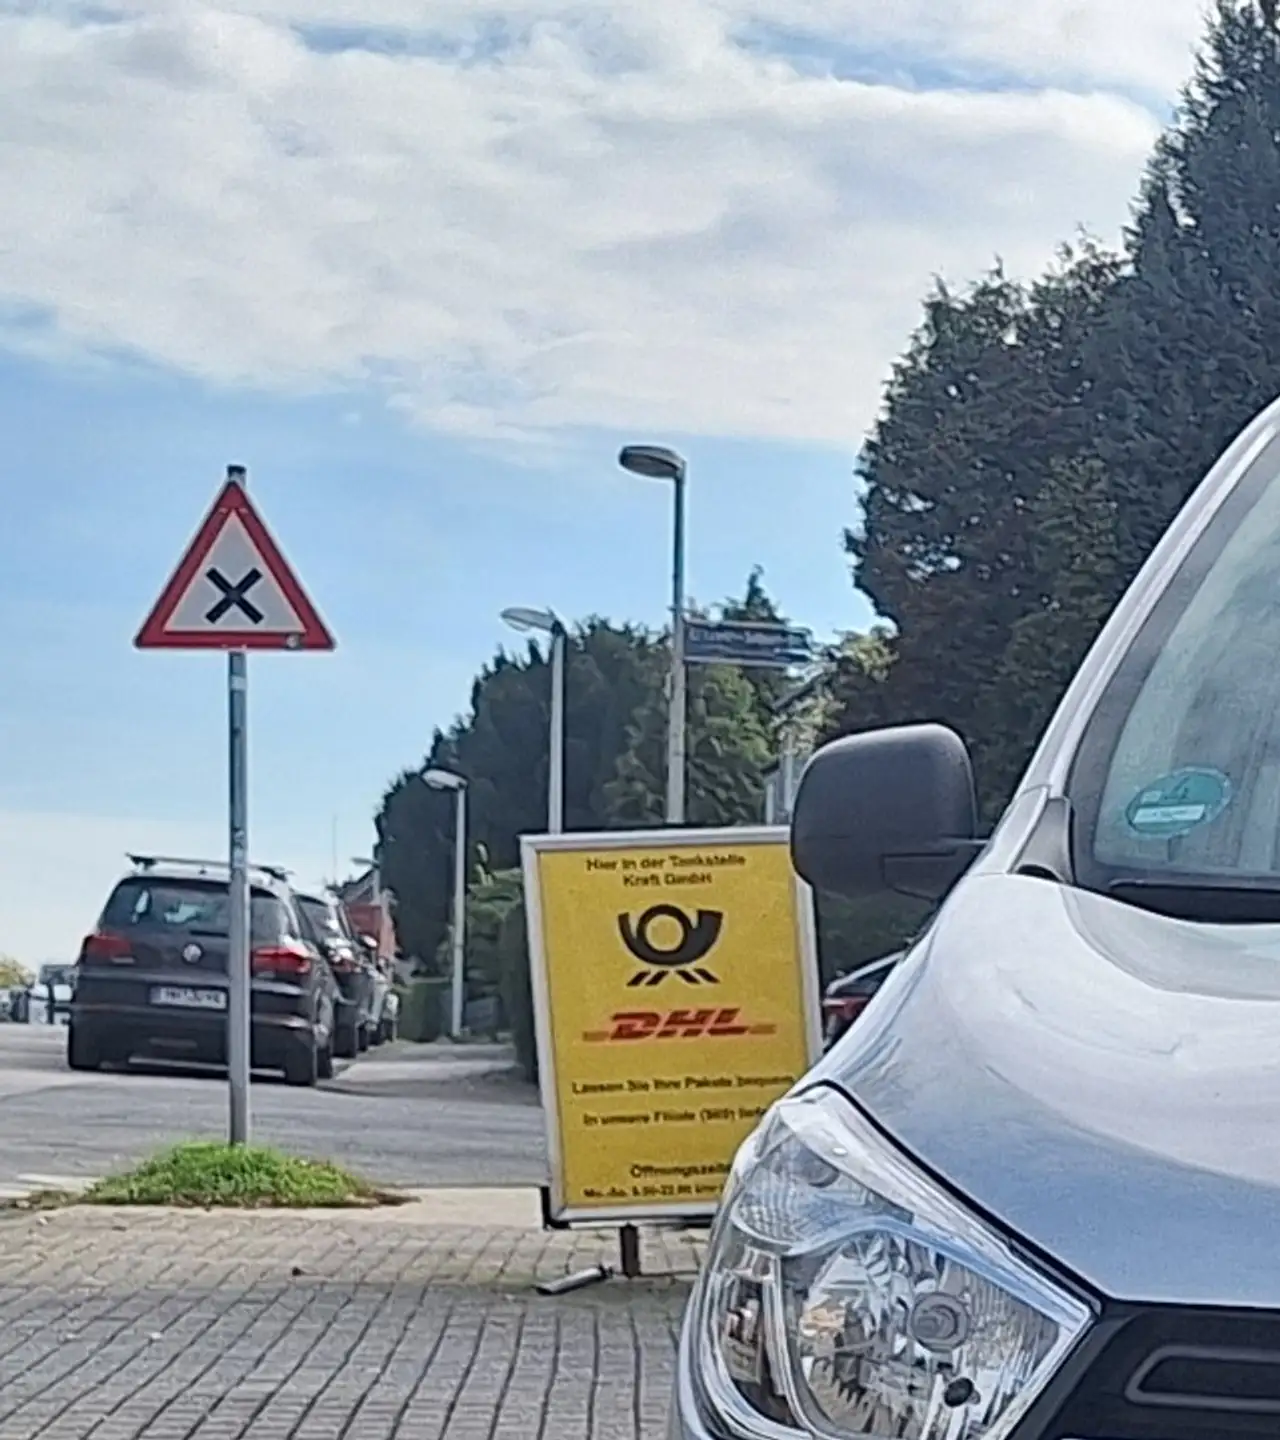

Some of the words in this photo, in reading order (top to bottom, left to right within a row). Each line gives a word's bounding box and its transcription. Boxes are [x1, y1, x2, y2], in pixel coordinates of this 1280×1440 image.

[640, 857, 665, 869] der
[670, 854, 746, 868] Tankstelle
[623, 875, 660, 887] Kraft
[665, 873, 712, 884] GmbH
[610, 1008, 748, 1040] DHL
